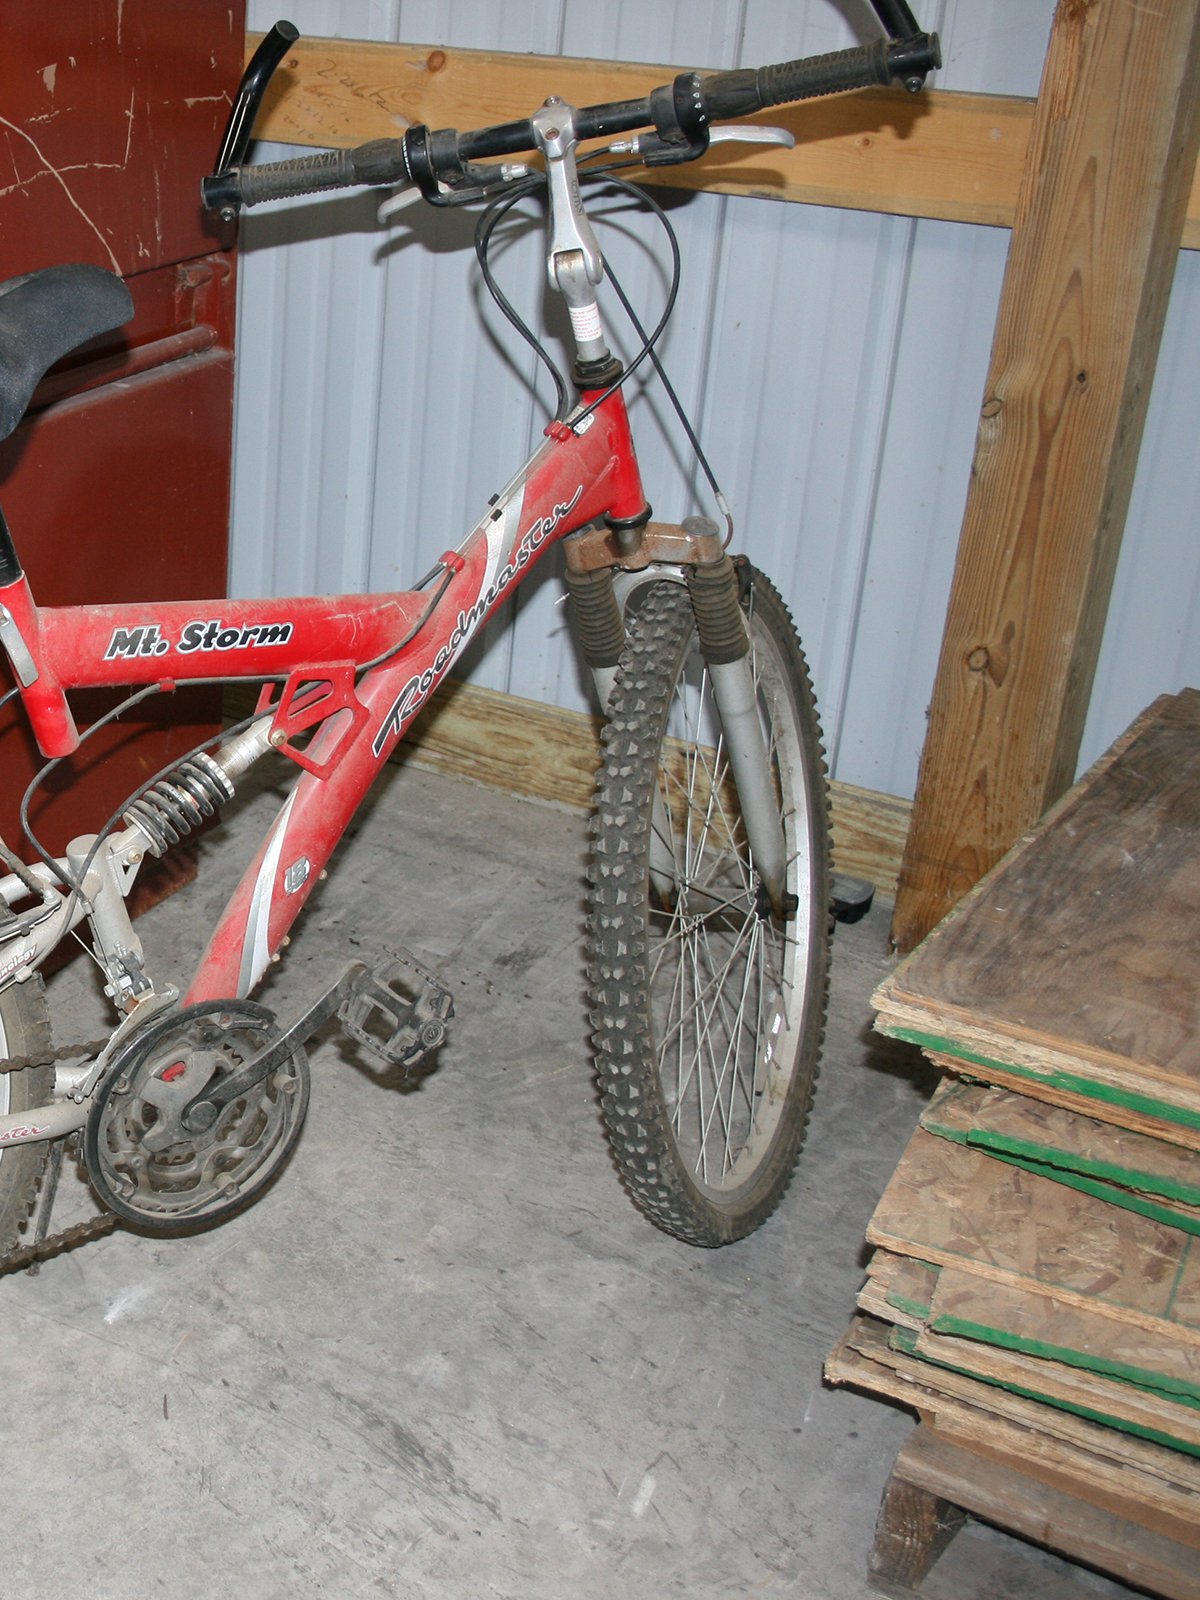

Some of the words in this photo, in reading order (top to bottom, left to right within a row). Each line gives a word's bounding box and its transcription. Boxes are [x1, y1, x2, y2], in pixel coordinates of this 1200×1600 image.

[103, 624, 171, 660] Mt.
[175, 619, 294, 654] Storm
[371, 485, 584, 758] Roadmaster
